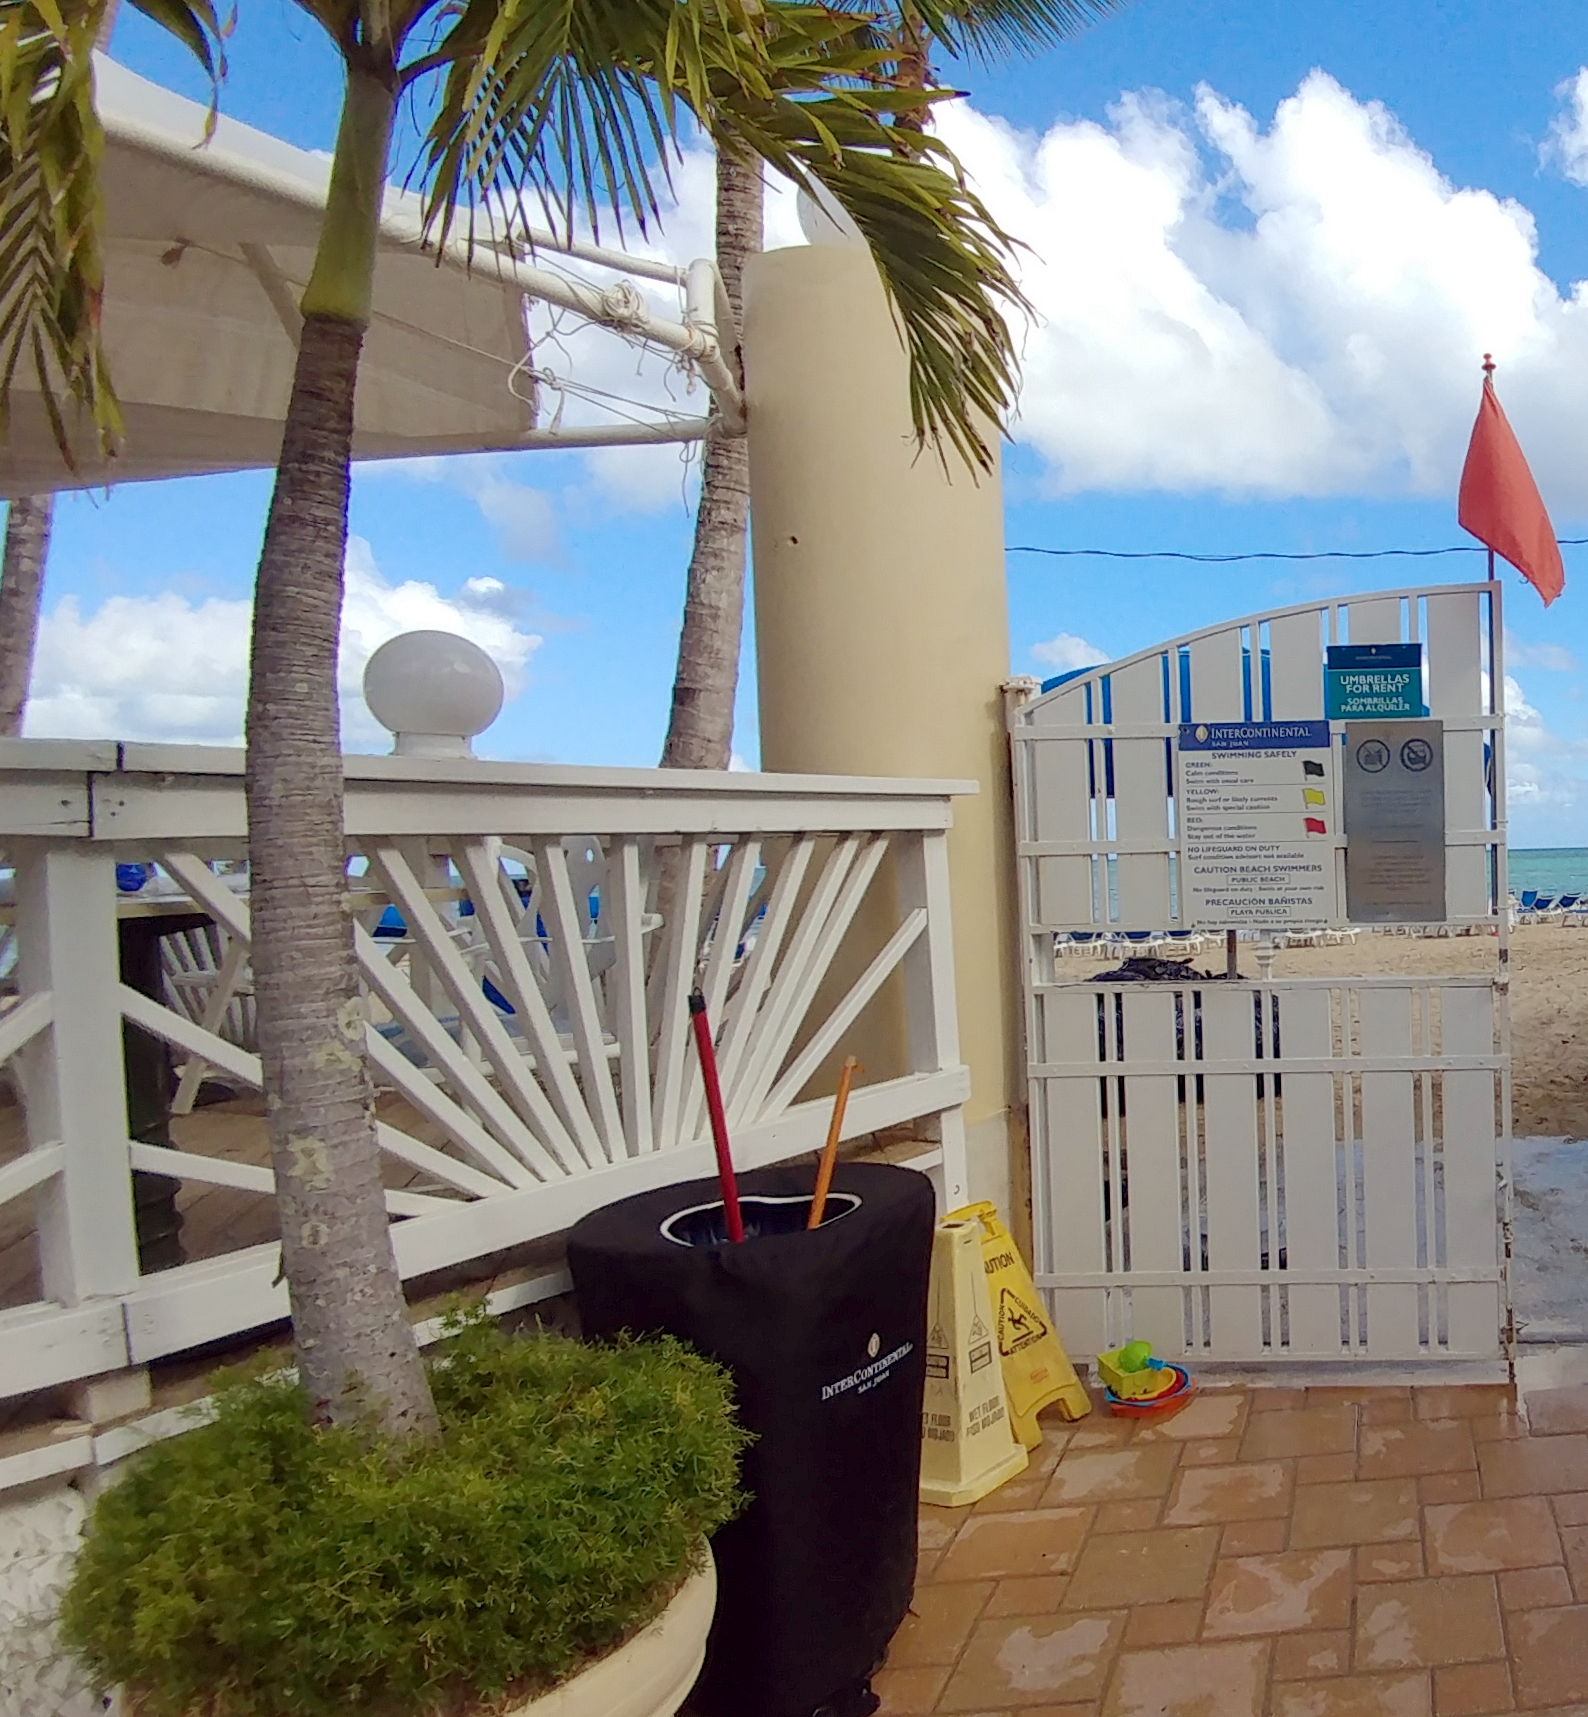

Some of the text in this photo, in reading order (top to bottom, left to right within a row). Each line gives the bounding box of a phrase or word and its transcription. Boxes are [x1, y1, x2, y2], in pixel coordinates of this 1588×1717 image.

[1340, 674, 1410, 685] UMBRELLAS
[1345, 684, 1404, 694] FOR RENT
[1347, 696, 1404, 705] SOMBRILLAS
[1340, 703, 1410, 712] PARA ALQUILER
[1194, 864, 1323, 874] CAUTION BEACH SWIMMERS
[1268, 896, 1313, 905] BAÑISTAS
[984, 1251, 1015, 1274] AUTION
[1015, 1297, 1040, 1323] CUIDADO
[857, 1369, 890, 1394] SAN JUAN
[968, 1405, 980, 1423] WET
